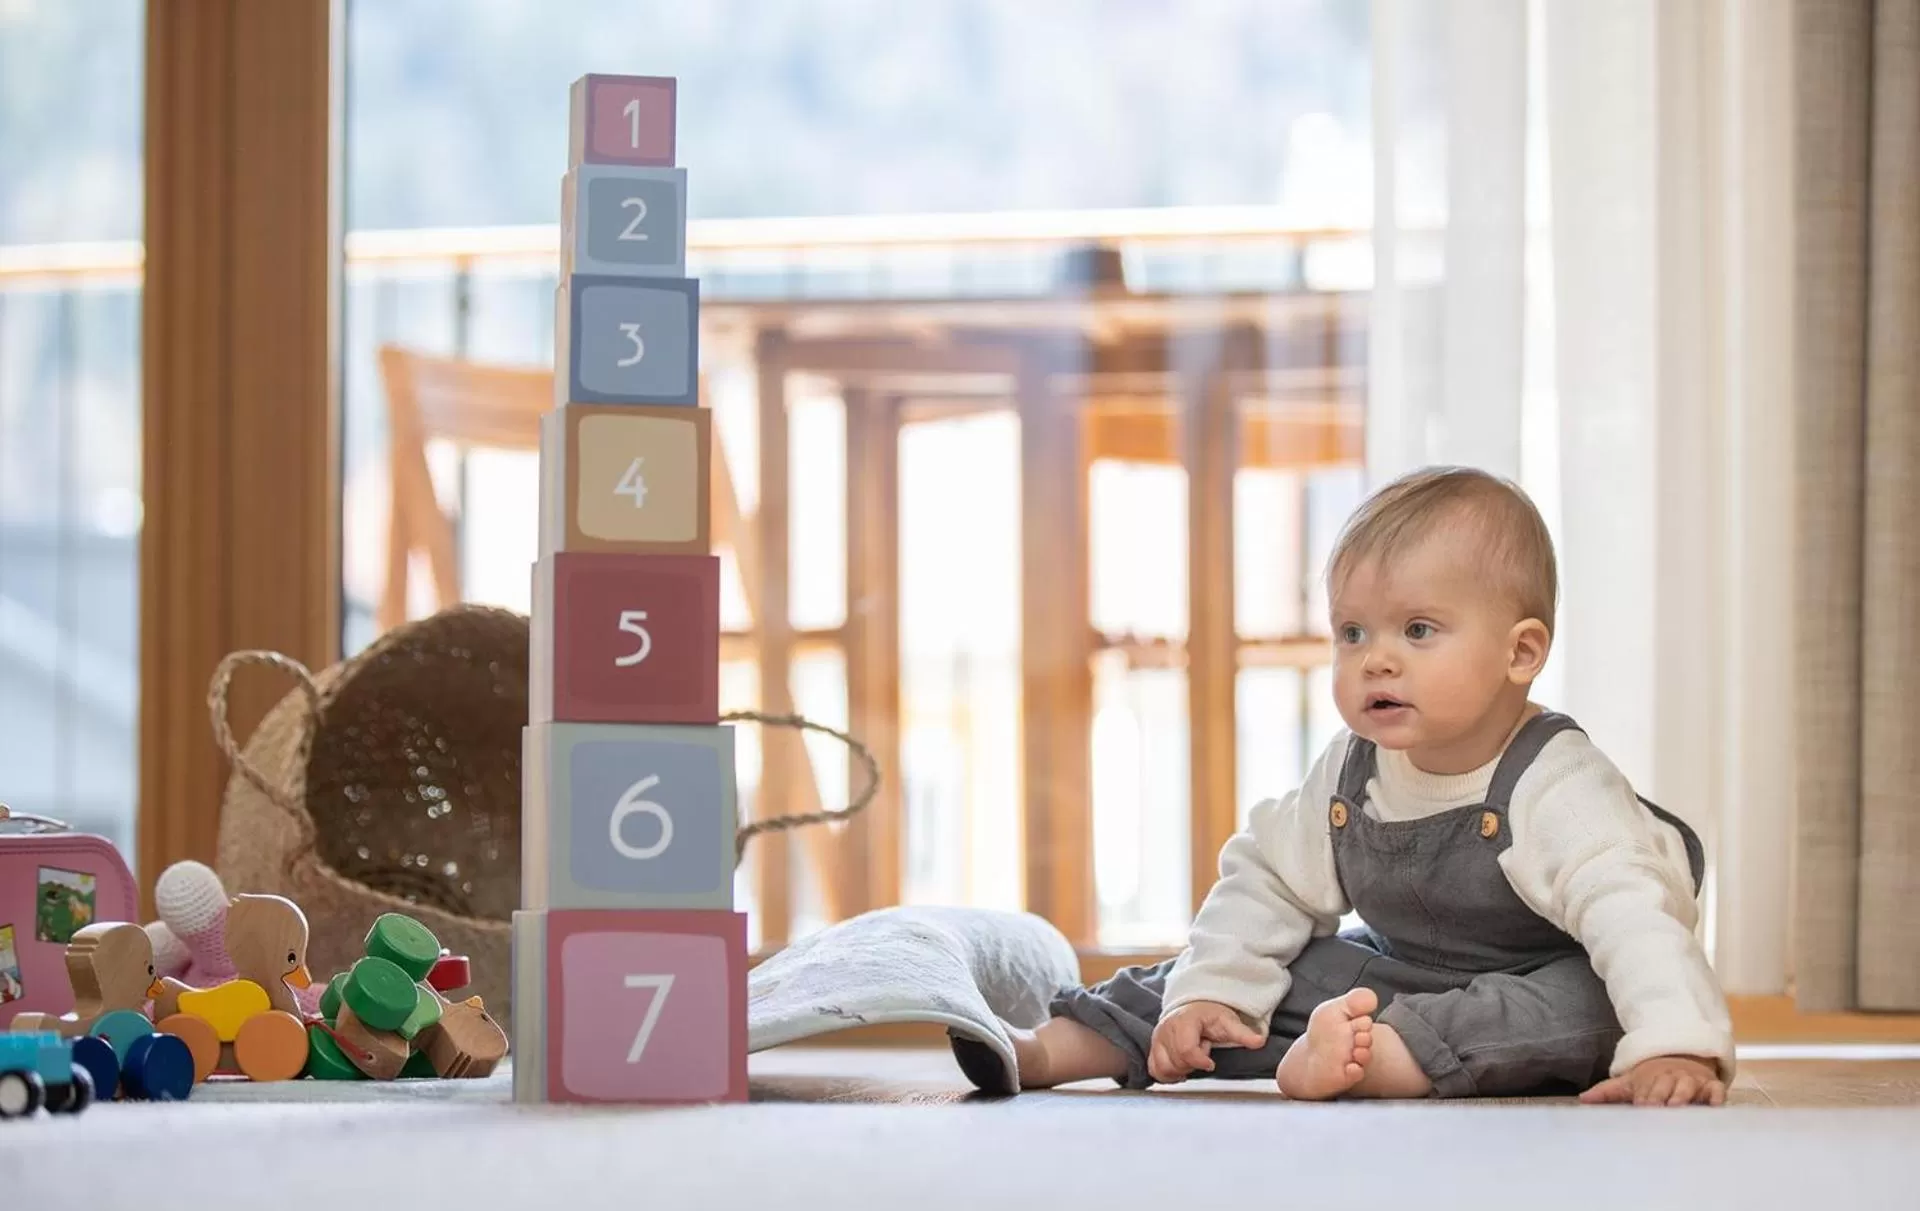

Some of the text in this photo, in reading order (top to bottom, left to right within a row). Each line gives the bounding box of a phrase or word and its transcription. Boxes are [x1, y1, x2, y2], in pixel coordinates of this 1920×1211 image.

[623, 99, 640, 148] 1
[619, 197, 648, 241] 2
[617, 323, 645, 367] 3
[613, 457, 648, 509] 4
[615, 611, 651, 667] 5
[609, 774, 673, 860] 6
[624, 973, 676, 1063] 7
